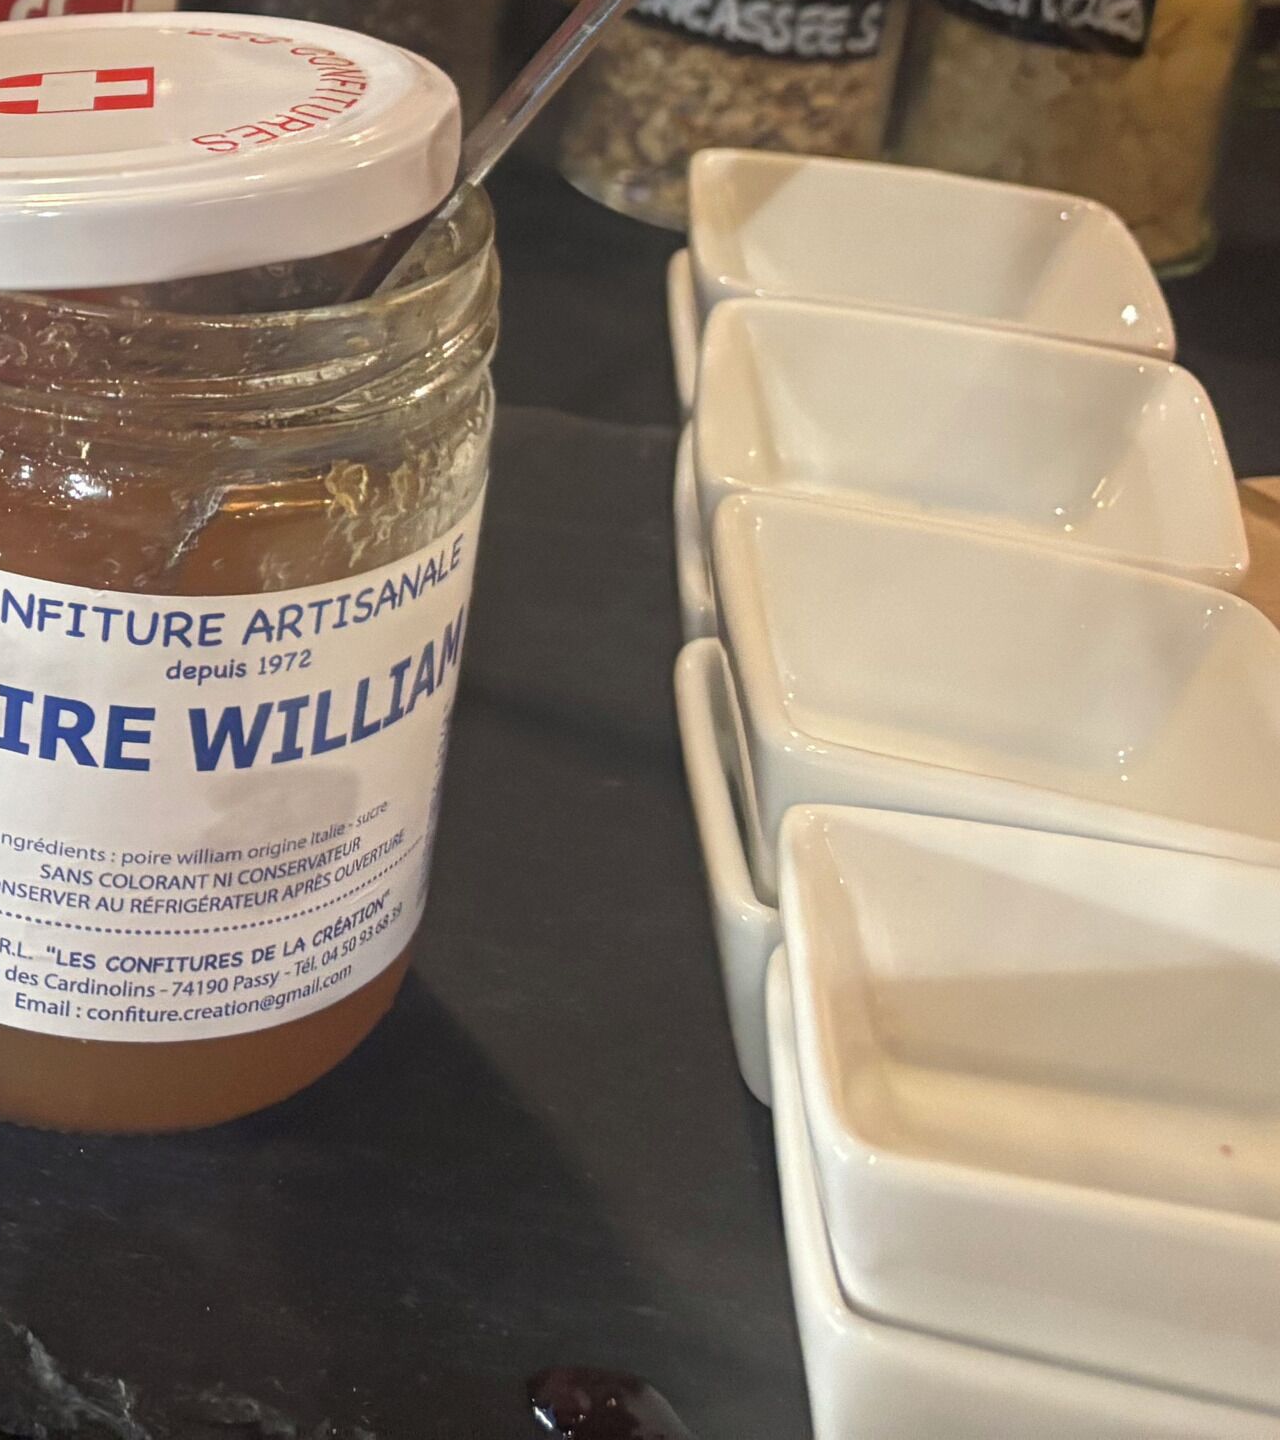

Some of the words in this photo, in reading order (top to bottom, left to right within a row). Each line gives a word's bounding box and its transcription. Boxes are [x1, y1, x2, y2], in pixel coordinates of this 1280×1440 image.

[241, 533, 464, 646] ARTISANALE
[166, 660, 247, 685] depuis
[258, 649, 312, 675] 1972
[188, 605, 465, 772] WILLIAM
[40, 864, 93, 885] SANS
[99, 872, 209, 890] COLORANT
[213, 873, 232, 888] NI
[238, 837, 361, 885] CONSERVATEUR
[121, 851, 172, 866] poire
[177, 848, 242, 865] william
[248, 836, 307, 859] origine
[311, 824, 345, 846] Italie
[356, 801, 388, 828] sucre
[96, 896, 123, 912] AU
[130, 888, 278, 914] RÉFRIGÉRATEUR
[282, 871, 330, 900] APRÈS
[335, 828, 405, 883] OUVERTURE
[5, 965, 38, 987] des
[44, 973, 155, 998] Cardinolins
[172, 977, 228, 997] 74190
[233, 969, 279, 992] Passy
[294, 957, 318, 977] Tél.
[322, 947, 338, 967] 04
[342, 936, 357, 958] 50
[46, 946, 96, 970] "LES
[106, 951, 243, 974] CONFITURES
[252, 945, 276, 964] DE
[283, 937, 305, 957] LA
[15, 992, 70, 1018] Email
[87, 964, 352, 1022] confiture.creation@gmail.com
